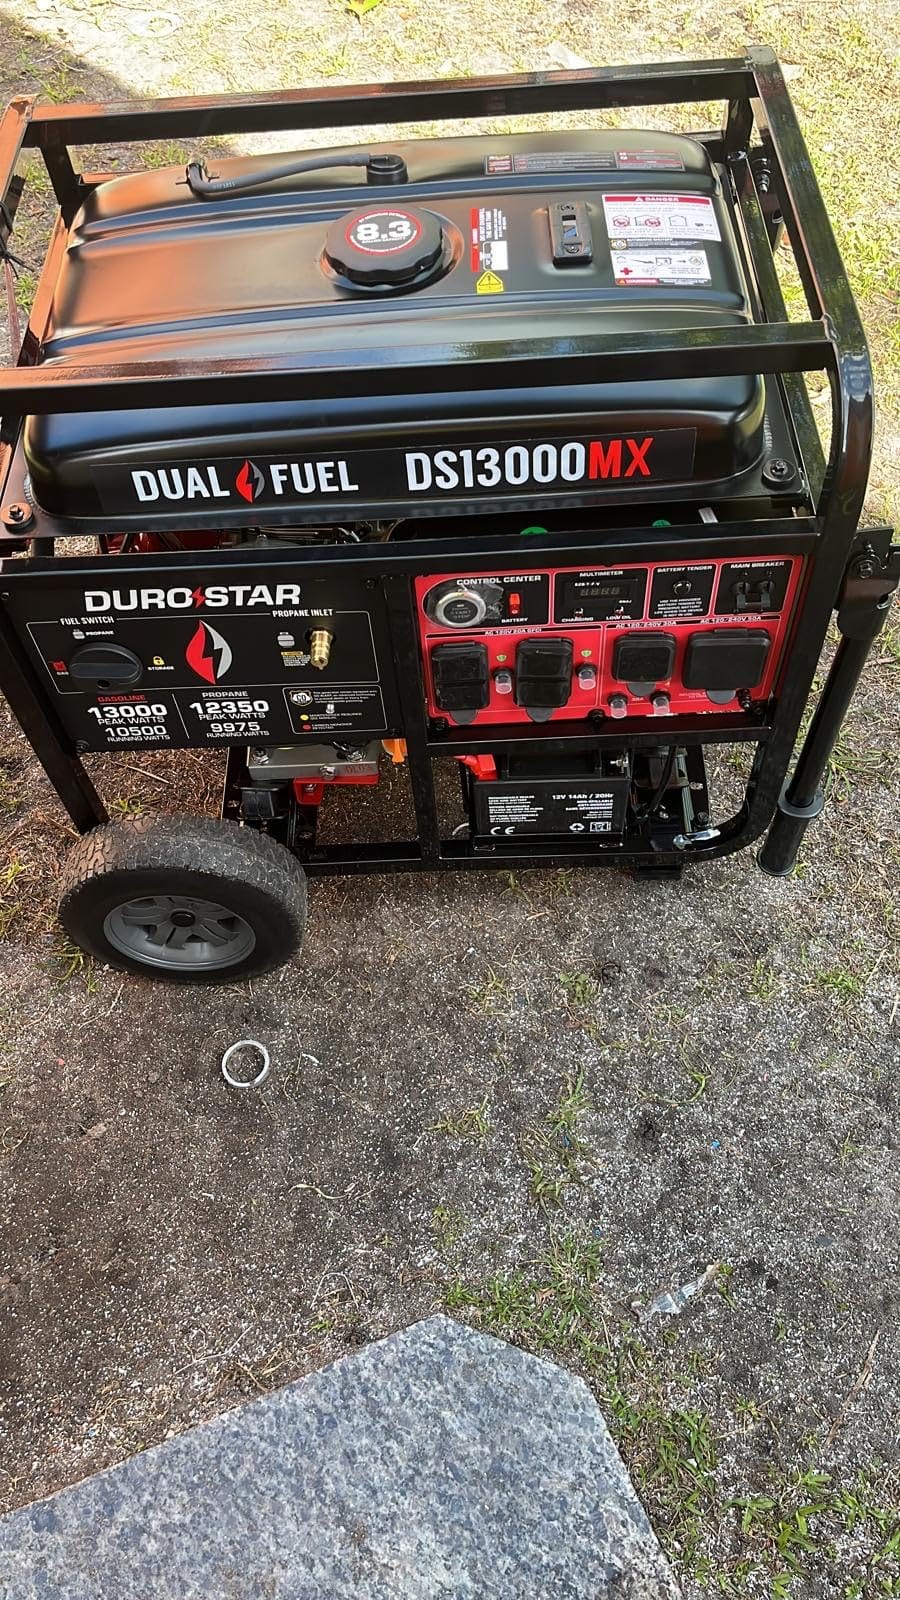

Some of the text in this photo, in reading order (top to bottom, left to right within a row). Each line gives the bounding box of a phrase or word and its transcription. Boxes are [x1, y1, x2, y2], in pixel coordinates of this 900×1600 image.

[356, 220, 412, 240] 8.3
[404, 437, 654, 491] DS13000MX
[131, 460, 359, 502] DUAL FUEL
[456, 578, 502, 586] CONTROL
[60, 616, 115, 626] FUEL SWITCH
[87, 704, 168, 719] 13000
[189, 700, 270, 714] 12350
[97, 716, 165, 726] PEAK WATTS
[198, 712, 266, 721] PEAK WATTS
[104, 725, 167, 738] 10500
[210, 722, 261, 733] 9975
